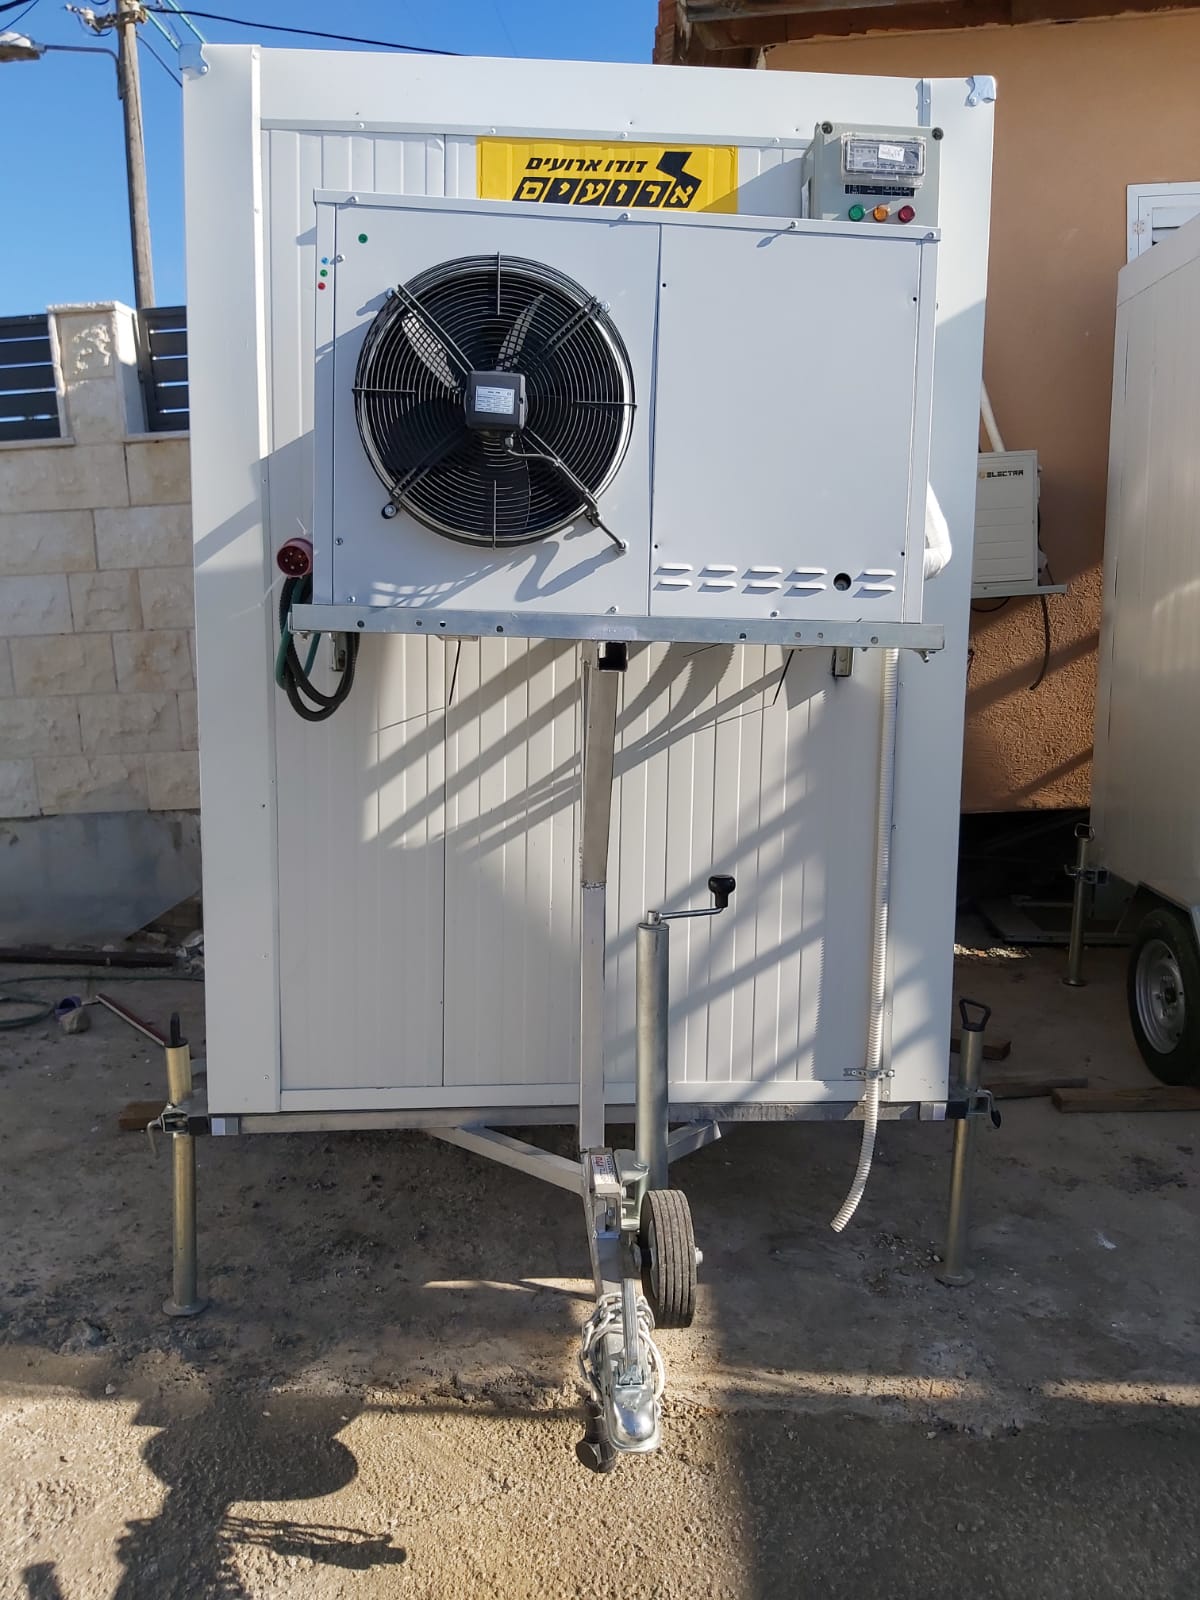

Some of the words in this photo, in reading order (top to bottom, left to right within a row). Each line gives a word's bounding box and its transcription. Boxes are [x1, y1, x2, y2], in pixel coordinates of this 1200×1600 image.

[525, 157, 602, 173] ארועים
[604, 160, 648, 173] דודו
[516, 179, 695, 206] ארועים
[986, 469, 1024, 478] ELECTRA
